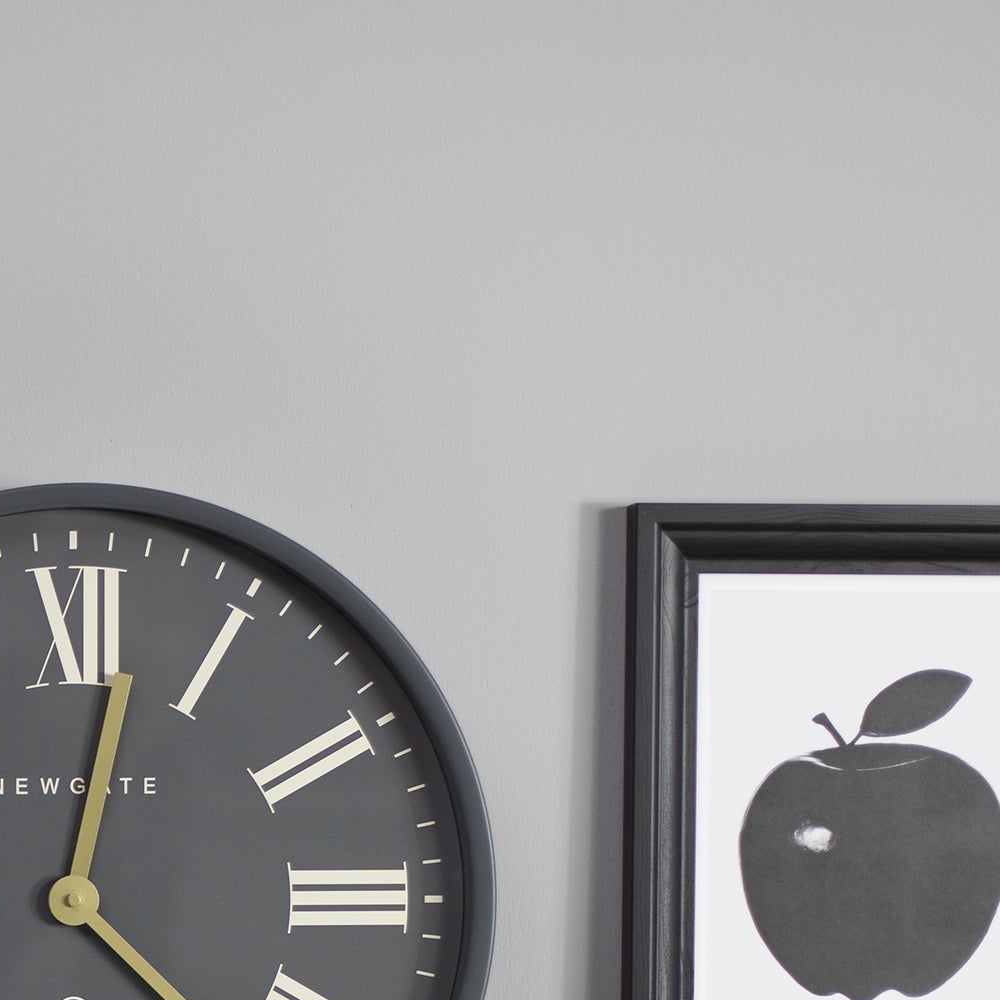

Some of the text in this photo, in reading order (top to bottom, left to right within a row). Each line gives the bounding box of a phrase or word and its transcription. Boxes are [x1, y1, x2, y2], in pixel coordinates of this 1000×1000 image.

[25, 566, 127, 688] XII
[169, 603, 254, 720] I
[247, 710, 375, 813] II
[287, 861, 408, 934] III
